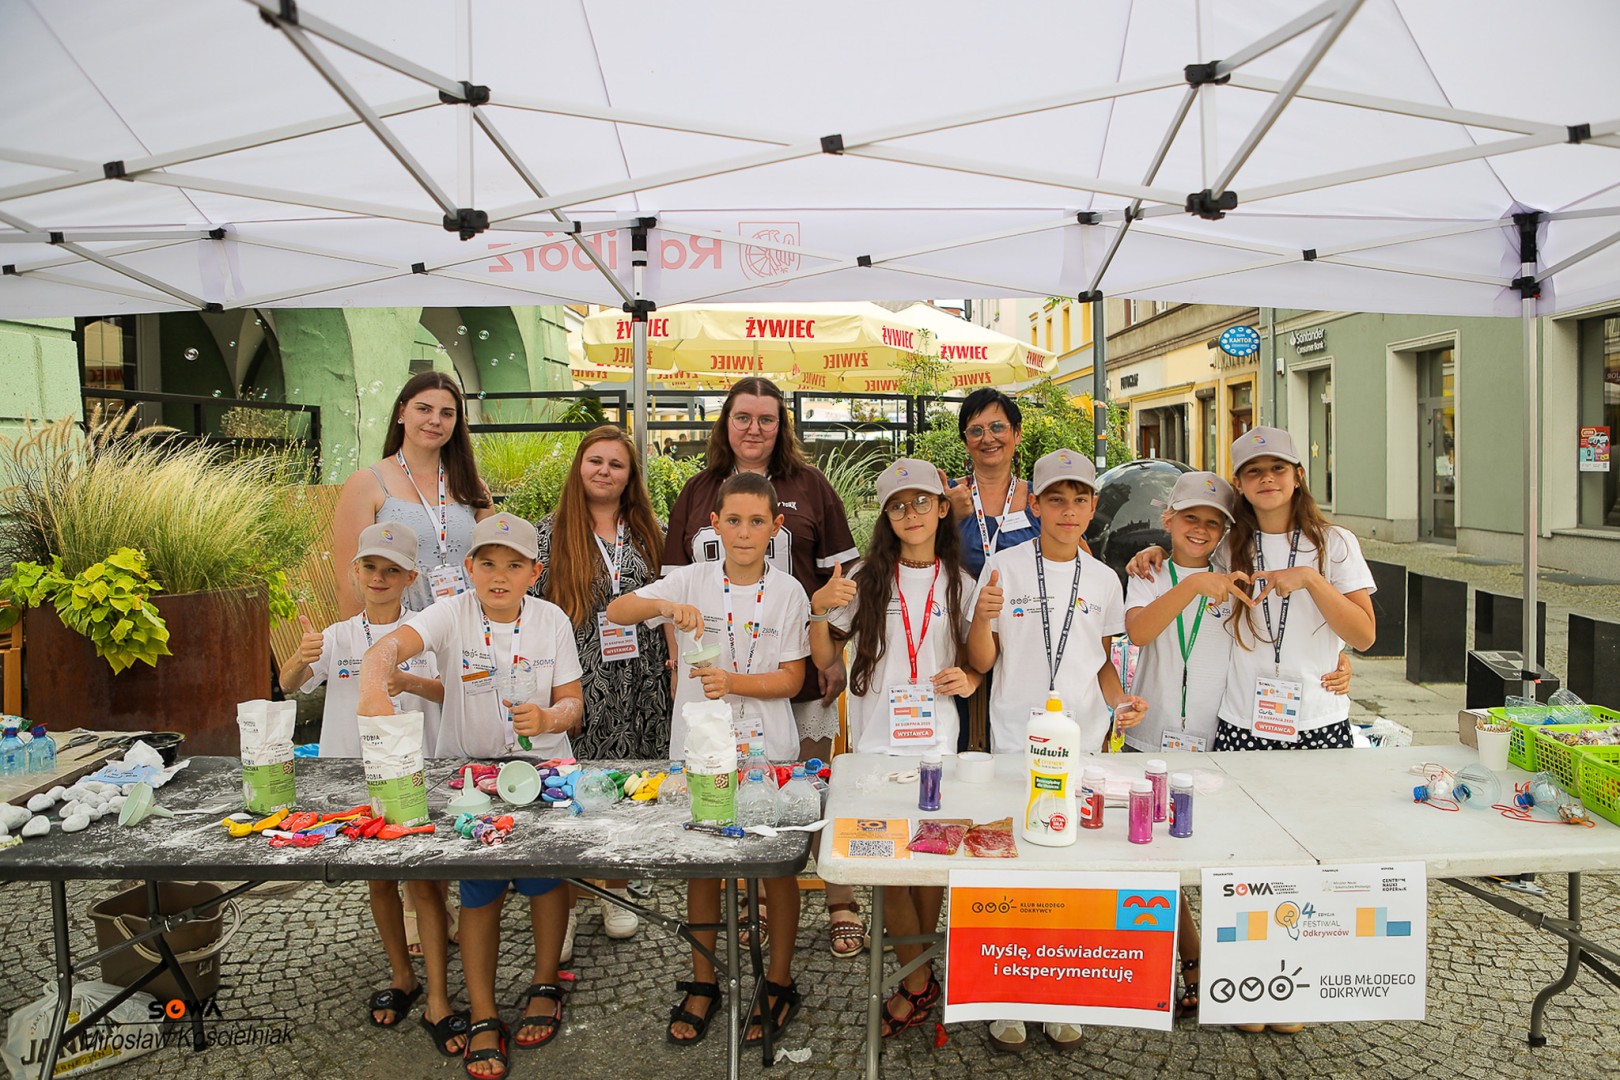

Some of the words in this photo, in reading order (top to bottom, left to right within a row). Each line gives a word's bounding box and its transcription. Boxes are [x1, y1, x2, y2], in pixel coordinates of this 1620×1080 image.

[616, 318, 669, 339] ŻYIEC
[746, 317, 815, 338] ŻYWIEC
[882, 325, 914, 349] ŻYWIEC
[1296, 328, 1325, 344] Santander
[940, 344, 988, 361] ŻYWIEC
[1259, 724, 1291, 733] WYSTAWCA
[1030, 745, 1069, 758] ludwik
[1223, 883, 1273, 897] SOWA
[1302, 902, 1316, 919] 4
[1303, 929, 1349, 938] Odkrywców
[981, 944, 1032, 959] Myślę,
[1036, 944, 1144, 960] doświadczam
[993, 964, 998, 975] i
[1002, 965, 1133, 982] eksperymentuję
[1320, 975, 1351, 986] KLUB
[1355, 974, 1416, 985] MŁODEGO
[1320, 987, 1390, 998] ODKRYWCY
